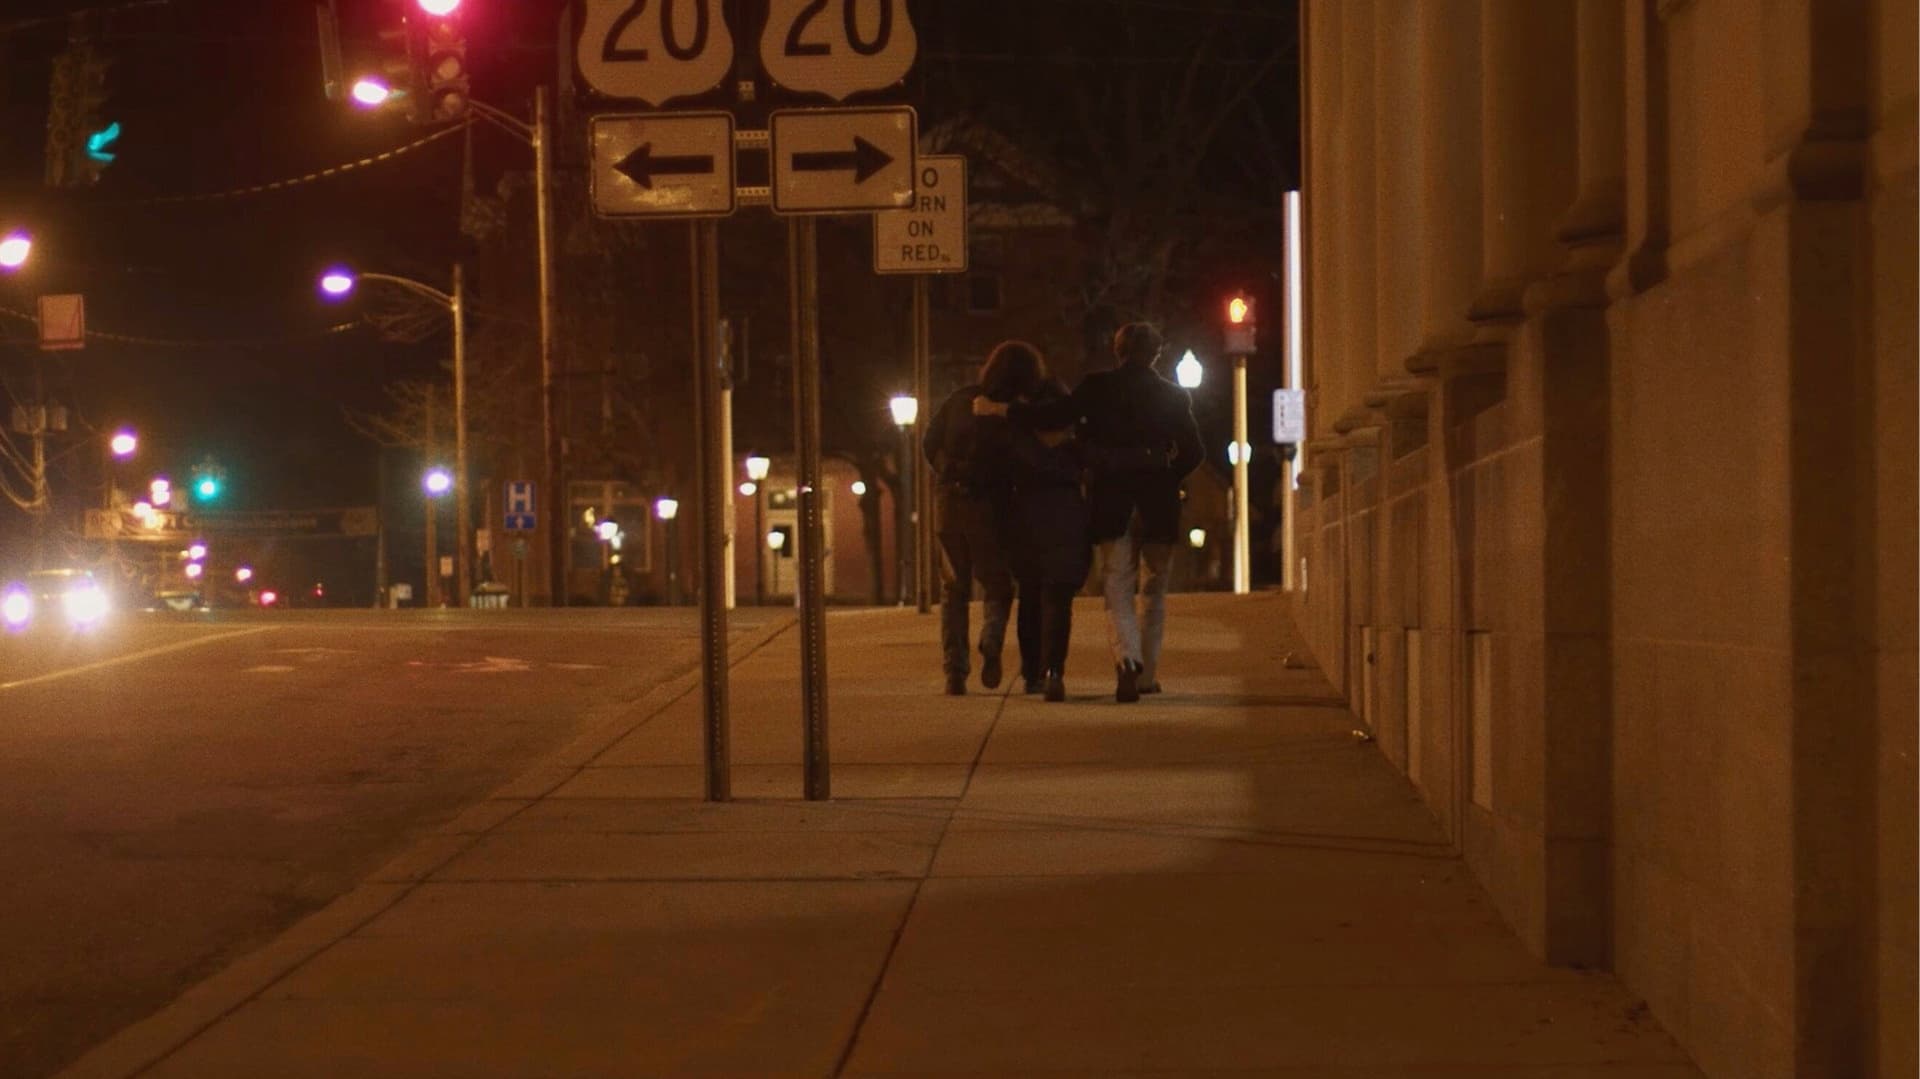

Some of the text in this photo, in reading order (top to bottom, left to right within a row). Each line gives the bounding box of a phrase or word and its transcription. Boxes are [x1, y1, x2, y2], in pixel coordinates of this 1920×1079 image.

[602, 0, 709, 62] 20
[784, 0, 893, 56] 20
[921, 167, 939, 188] O
[914, 195, 946, 212] RN
[908, 220, 934, 237] ON
[902, 244, 940, 261] RED
[509, 483, 531, 511] H
